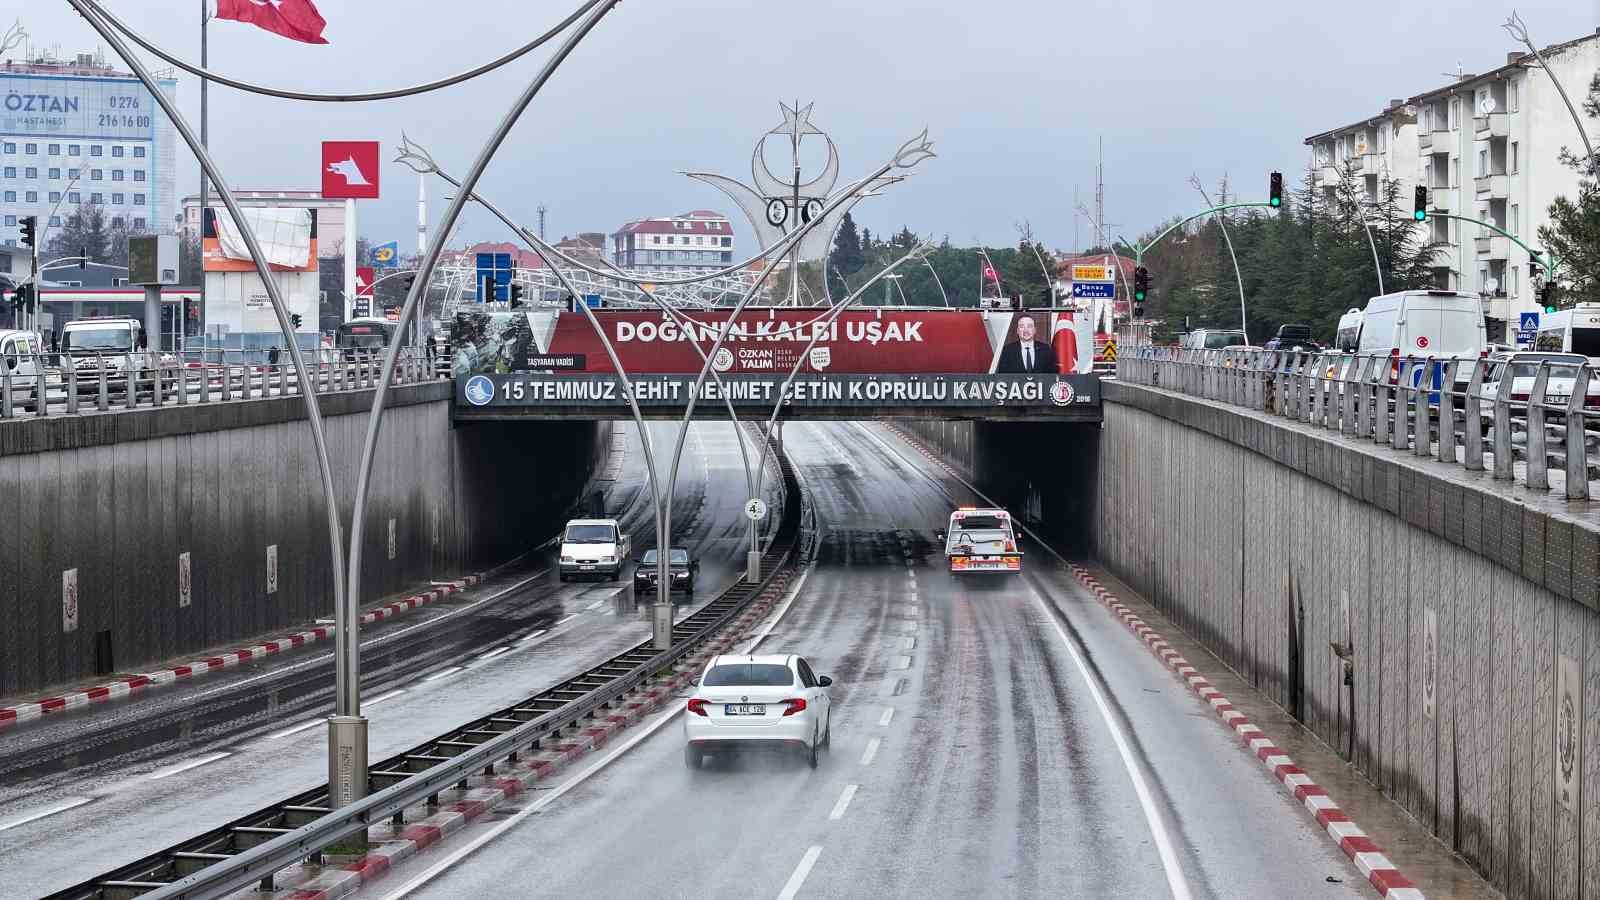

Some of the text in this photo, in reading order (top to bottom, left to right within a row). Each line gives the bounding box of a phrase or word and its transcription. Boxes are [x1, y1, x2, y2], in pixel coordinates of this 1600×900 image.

[5, 89, 79, 113] ÖZTAN
[119, 96, 139, 109] 276
[98, 114, 150, 128] 216 16 00
[847, 321, 924, 345] UŞAK
[738, 348, 773, 358] ÖZKAN
[741, 359, 773, 369] YALIM
[502, 381, 524, 399] 15
[530, 381, 616, 400] TEMMUZ
[688, 381, 774, 400] MEHMET
[849, 377, 946, 400] KÖPRÜLÜ
[953, 377, 1043, 406] KAVŞAĞI
